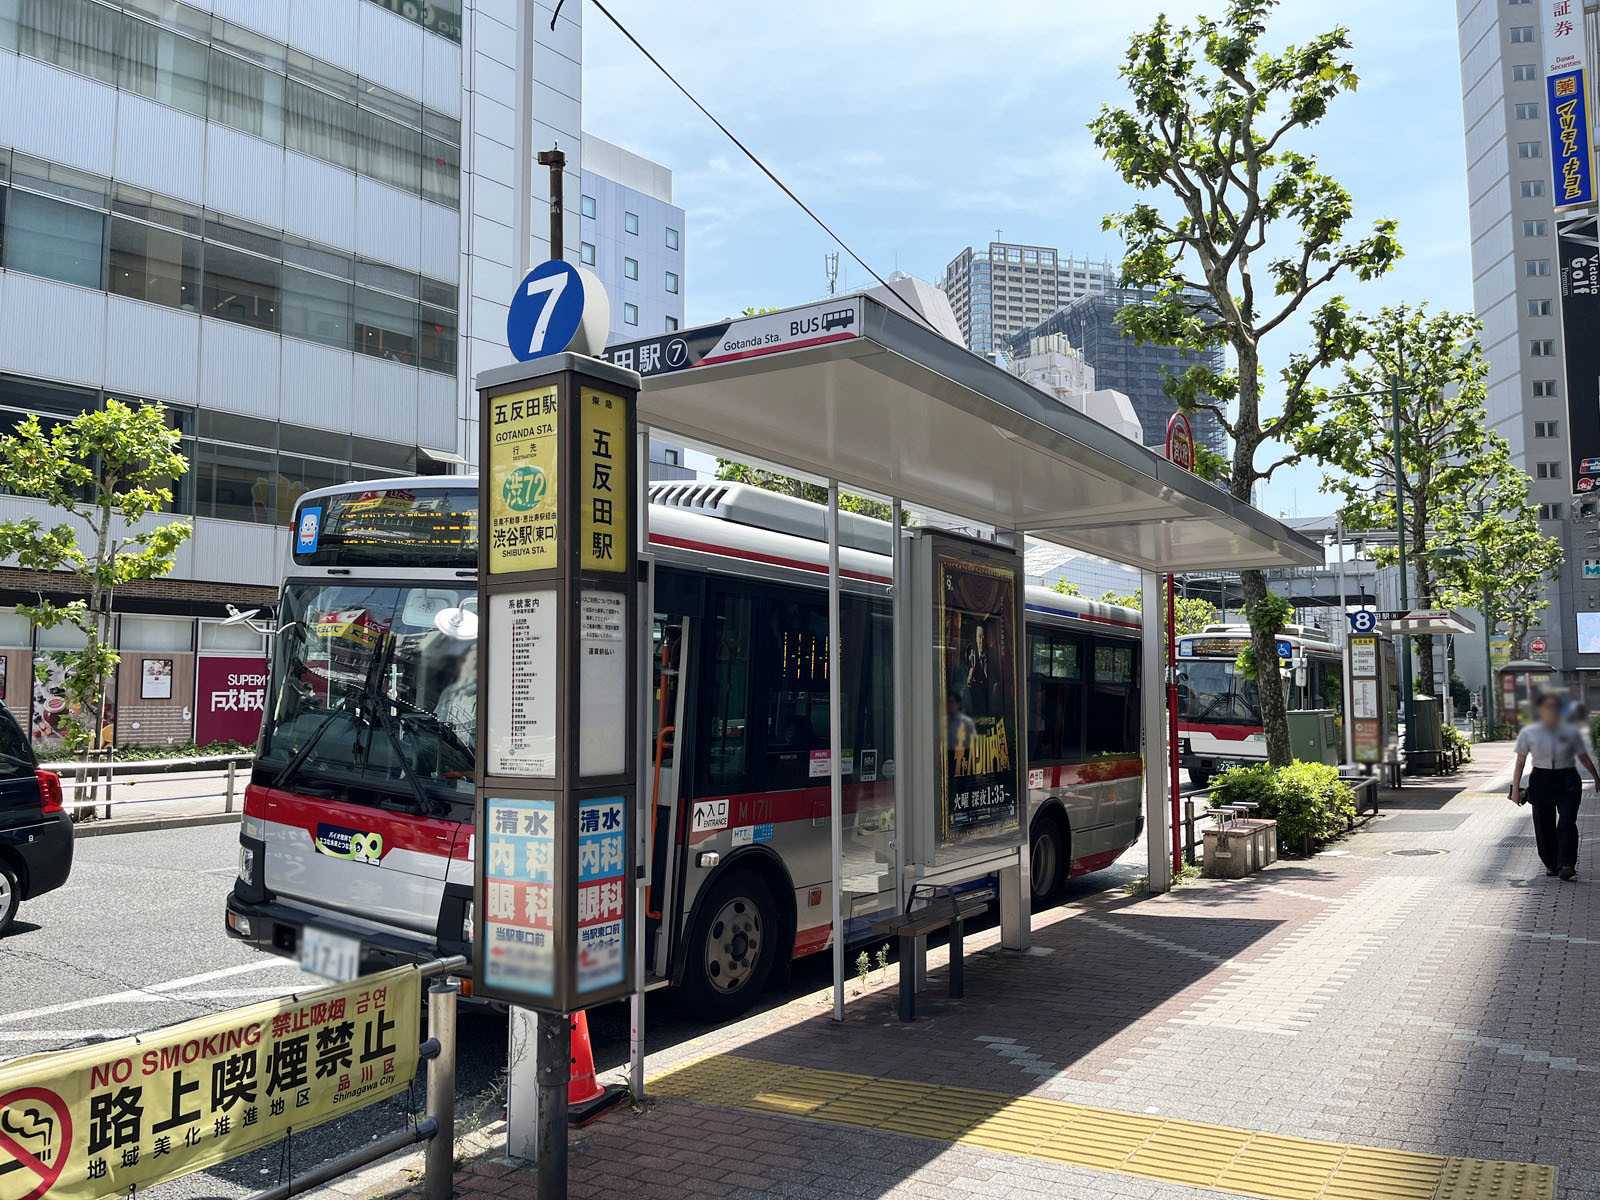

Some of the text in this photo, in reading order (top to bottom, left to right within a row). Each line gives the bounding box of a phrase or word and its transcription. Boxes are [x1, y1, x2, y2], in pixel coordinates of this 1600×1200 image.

[1550, 60, 1582, 71] Securities
[1556, 54, 1575, 63] Daiwa
[1561, 267, 1570, 297] Premium
[1571, 257, 1590, 294] Golf
[1589, 254, 1600, 295] Victoria
[526, 271, 569, 354] 7
[723, 316, 820, 352] Gotanda Sta. BUS
[494, 393, 557, 425] 五反田駅
[495, 424, 555, 442] GOTANDA STA.
[592, 428, 613, 561] 五反田駅
[493, 523, 557, 549] 渋谷駅(東口)
[502, 545, 547, 558] SHIBUYA STA.
[1355, 612, 1371, 630] 8
[210, 688, 265, 712] 成城
[707, 803, 726, 817] 入口
[954, 791, 970, 811] 火曜
[496, 809, 549, 837] 清水
[580, 807, 621, 833] 清水
[703, 817, 727, 828] ENTRANCE
[489, 838, 555, 881] 内科
[578, 835, 624, 877] 内科
[488, 882, 555, 926] 眼科
[578, 880, 624, 922] 眼科
[495, 926, 546, 948] 当駅東口前
[582, 922, 621, 942] 当駅東口前
[90, 986, 387, 1090] NO SMOKING 禁止吸烟 금연
[88, 1010, 397, 1156] 路上喫煙禁止
[333, 1074, 396, 1105] Shinagawa City
[338, 1057, 395, 1092] 品川区
[87, 1087, 311, 1180] 地域美化推進地区
